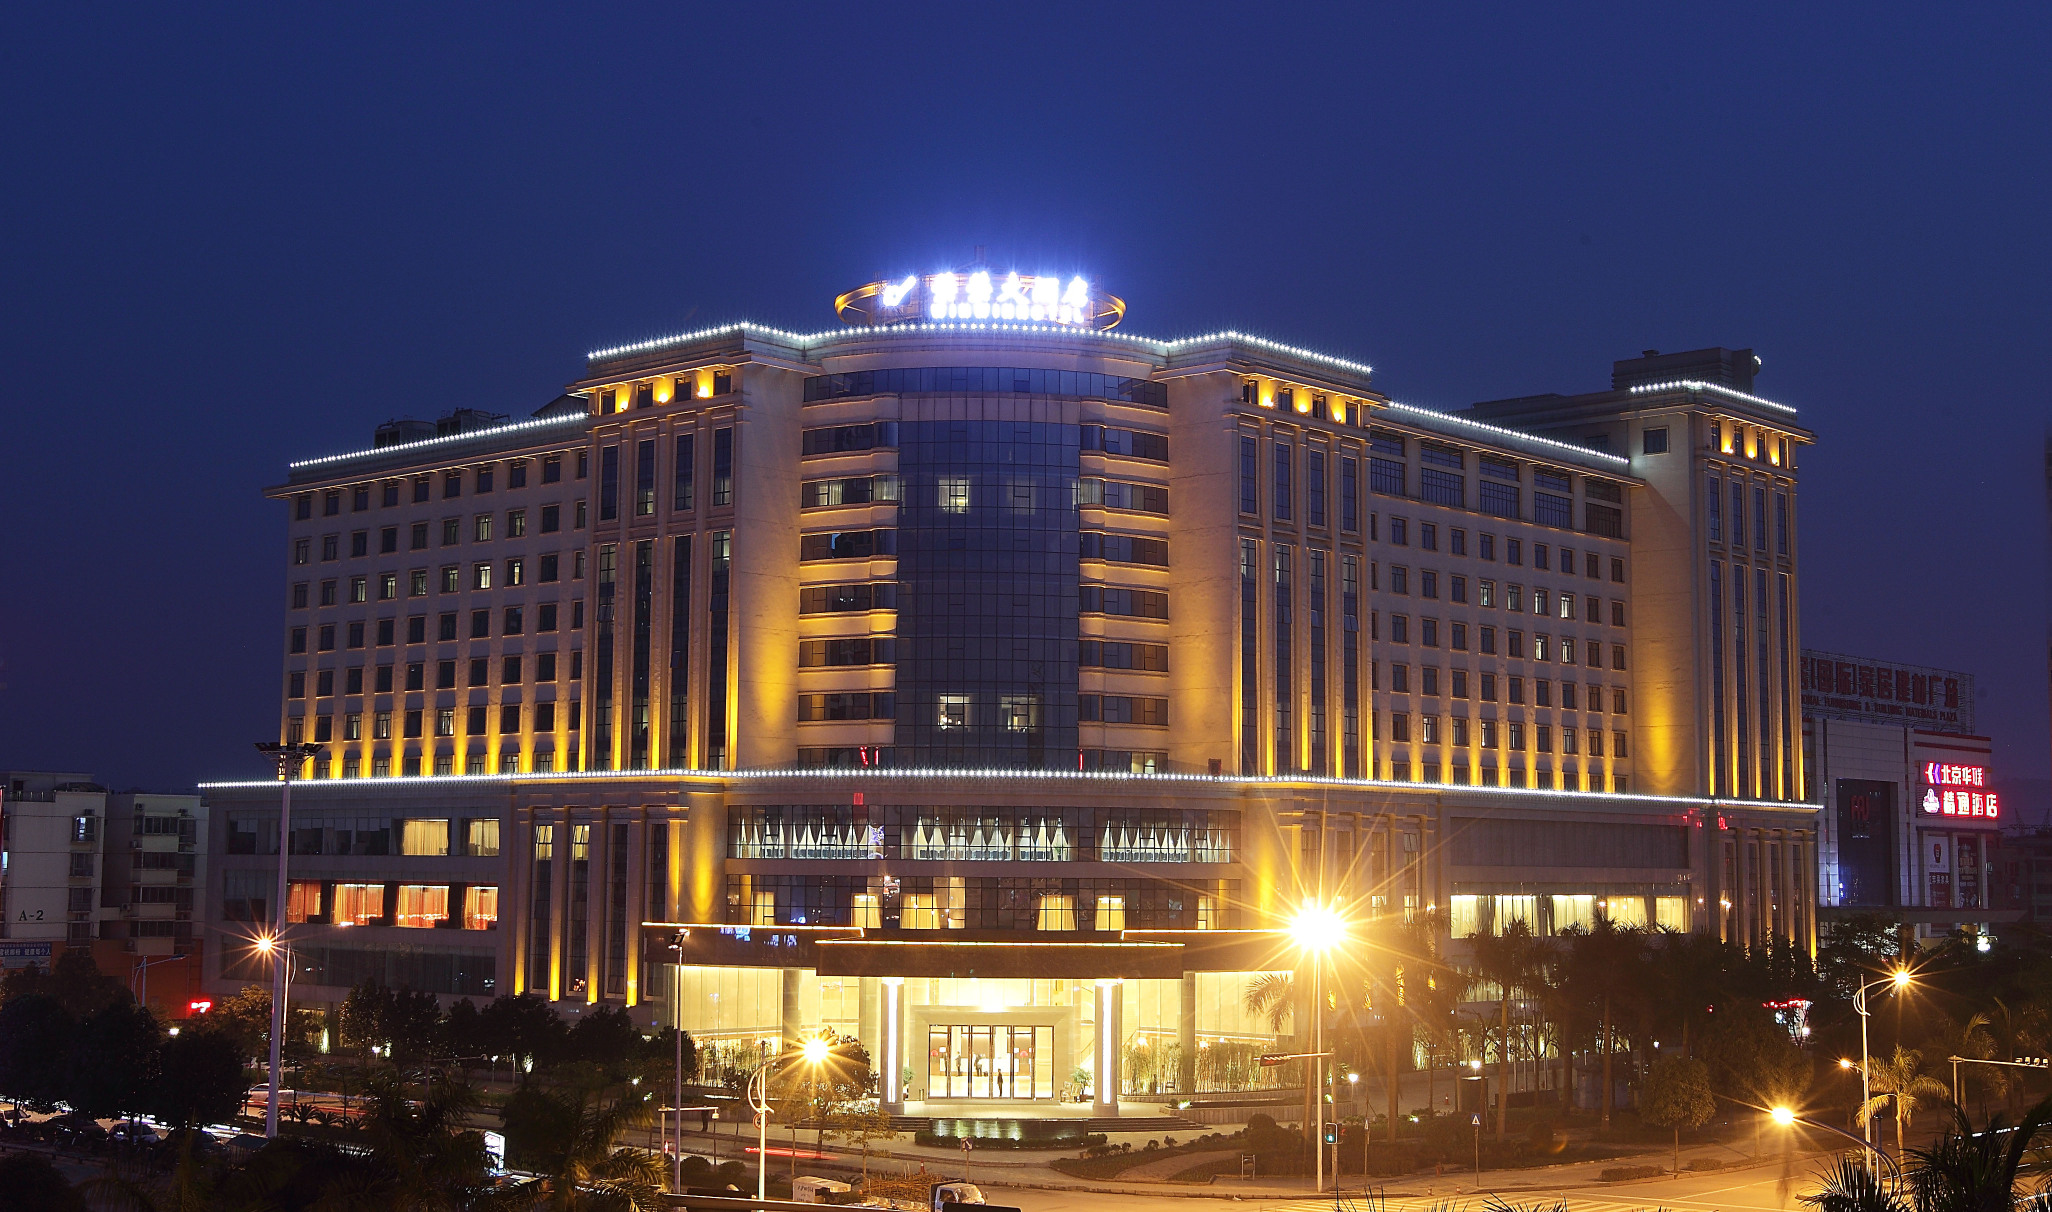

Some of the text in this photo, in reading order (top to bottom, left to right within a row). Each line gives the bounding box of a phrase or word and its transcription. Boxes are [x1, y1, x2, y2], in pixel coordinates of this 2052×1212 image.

[1874, 702, 1903, 716] BUILDING
[1906, 706, 1938, 720] MATERIALS
[1939, 711, 1958, 723] PLAZA
[1941, 764, 1983, 787] 北京华联
[18, 909, 44, 921] A-2
